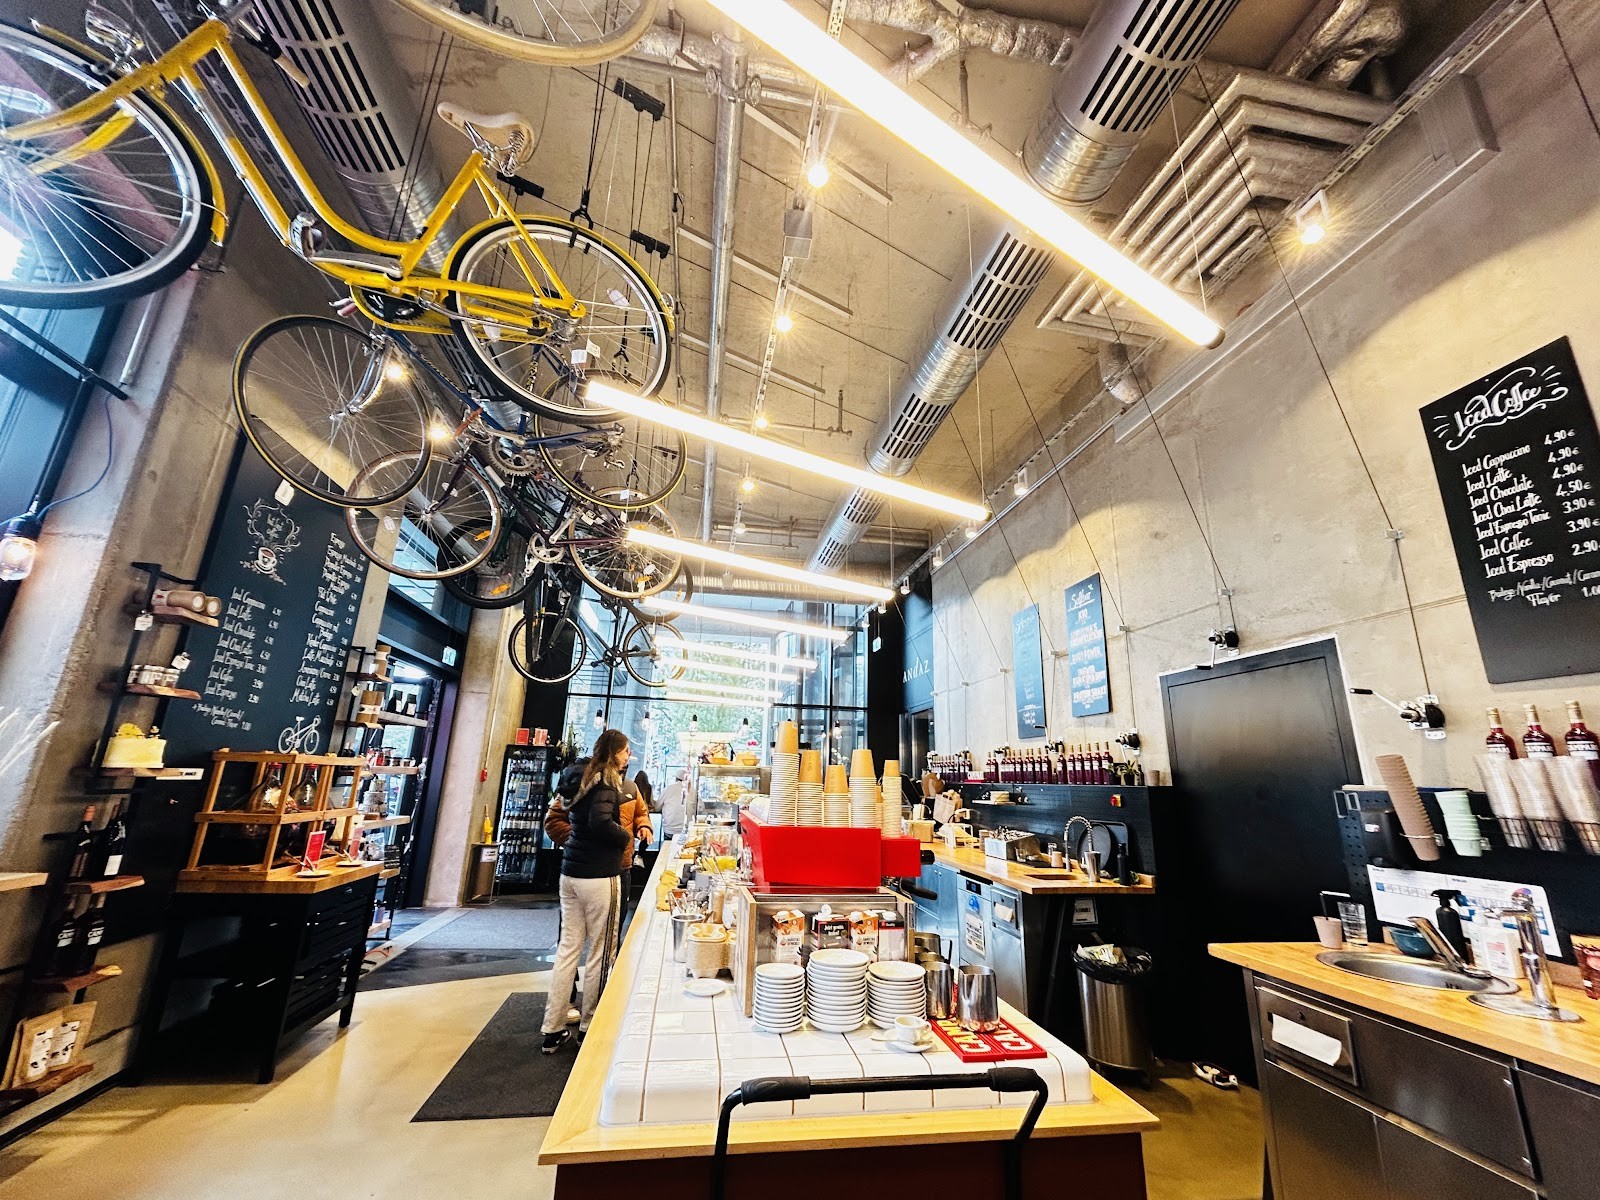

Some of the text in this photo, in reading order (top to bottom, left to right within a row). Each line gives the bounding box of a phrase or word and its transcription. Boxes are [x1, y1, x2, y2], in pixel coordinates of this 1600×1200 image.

[1491, 381, 1542, 417] Coffee
[1462, 458, 1482, 478] Iced
[1483, 444, 1531, 469] Cappuccino
[1466, 474, 1486, 496] Iced
[1486, 467, 1513, 489] Latte
[1469, 488, 1489, 510] Iced
[1490, 473, 1535, 501] Chocolate
[1472, 504, 1493, 526] Iced
[1493, 500, 1516, 518] Chai
[1515, 492, 1543, 512] Latte
[1476, 521, 1495, 541] Iced
[1493, 518, 1529, 535] Espresso
[1479, 538, 1500, 561] Iced
[1500, 531, 1534, 554] Coffee
[1484, 539, 1600, 579] Iced Espresso 2.90
